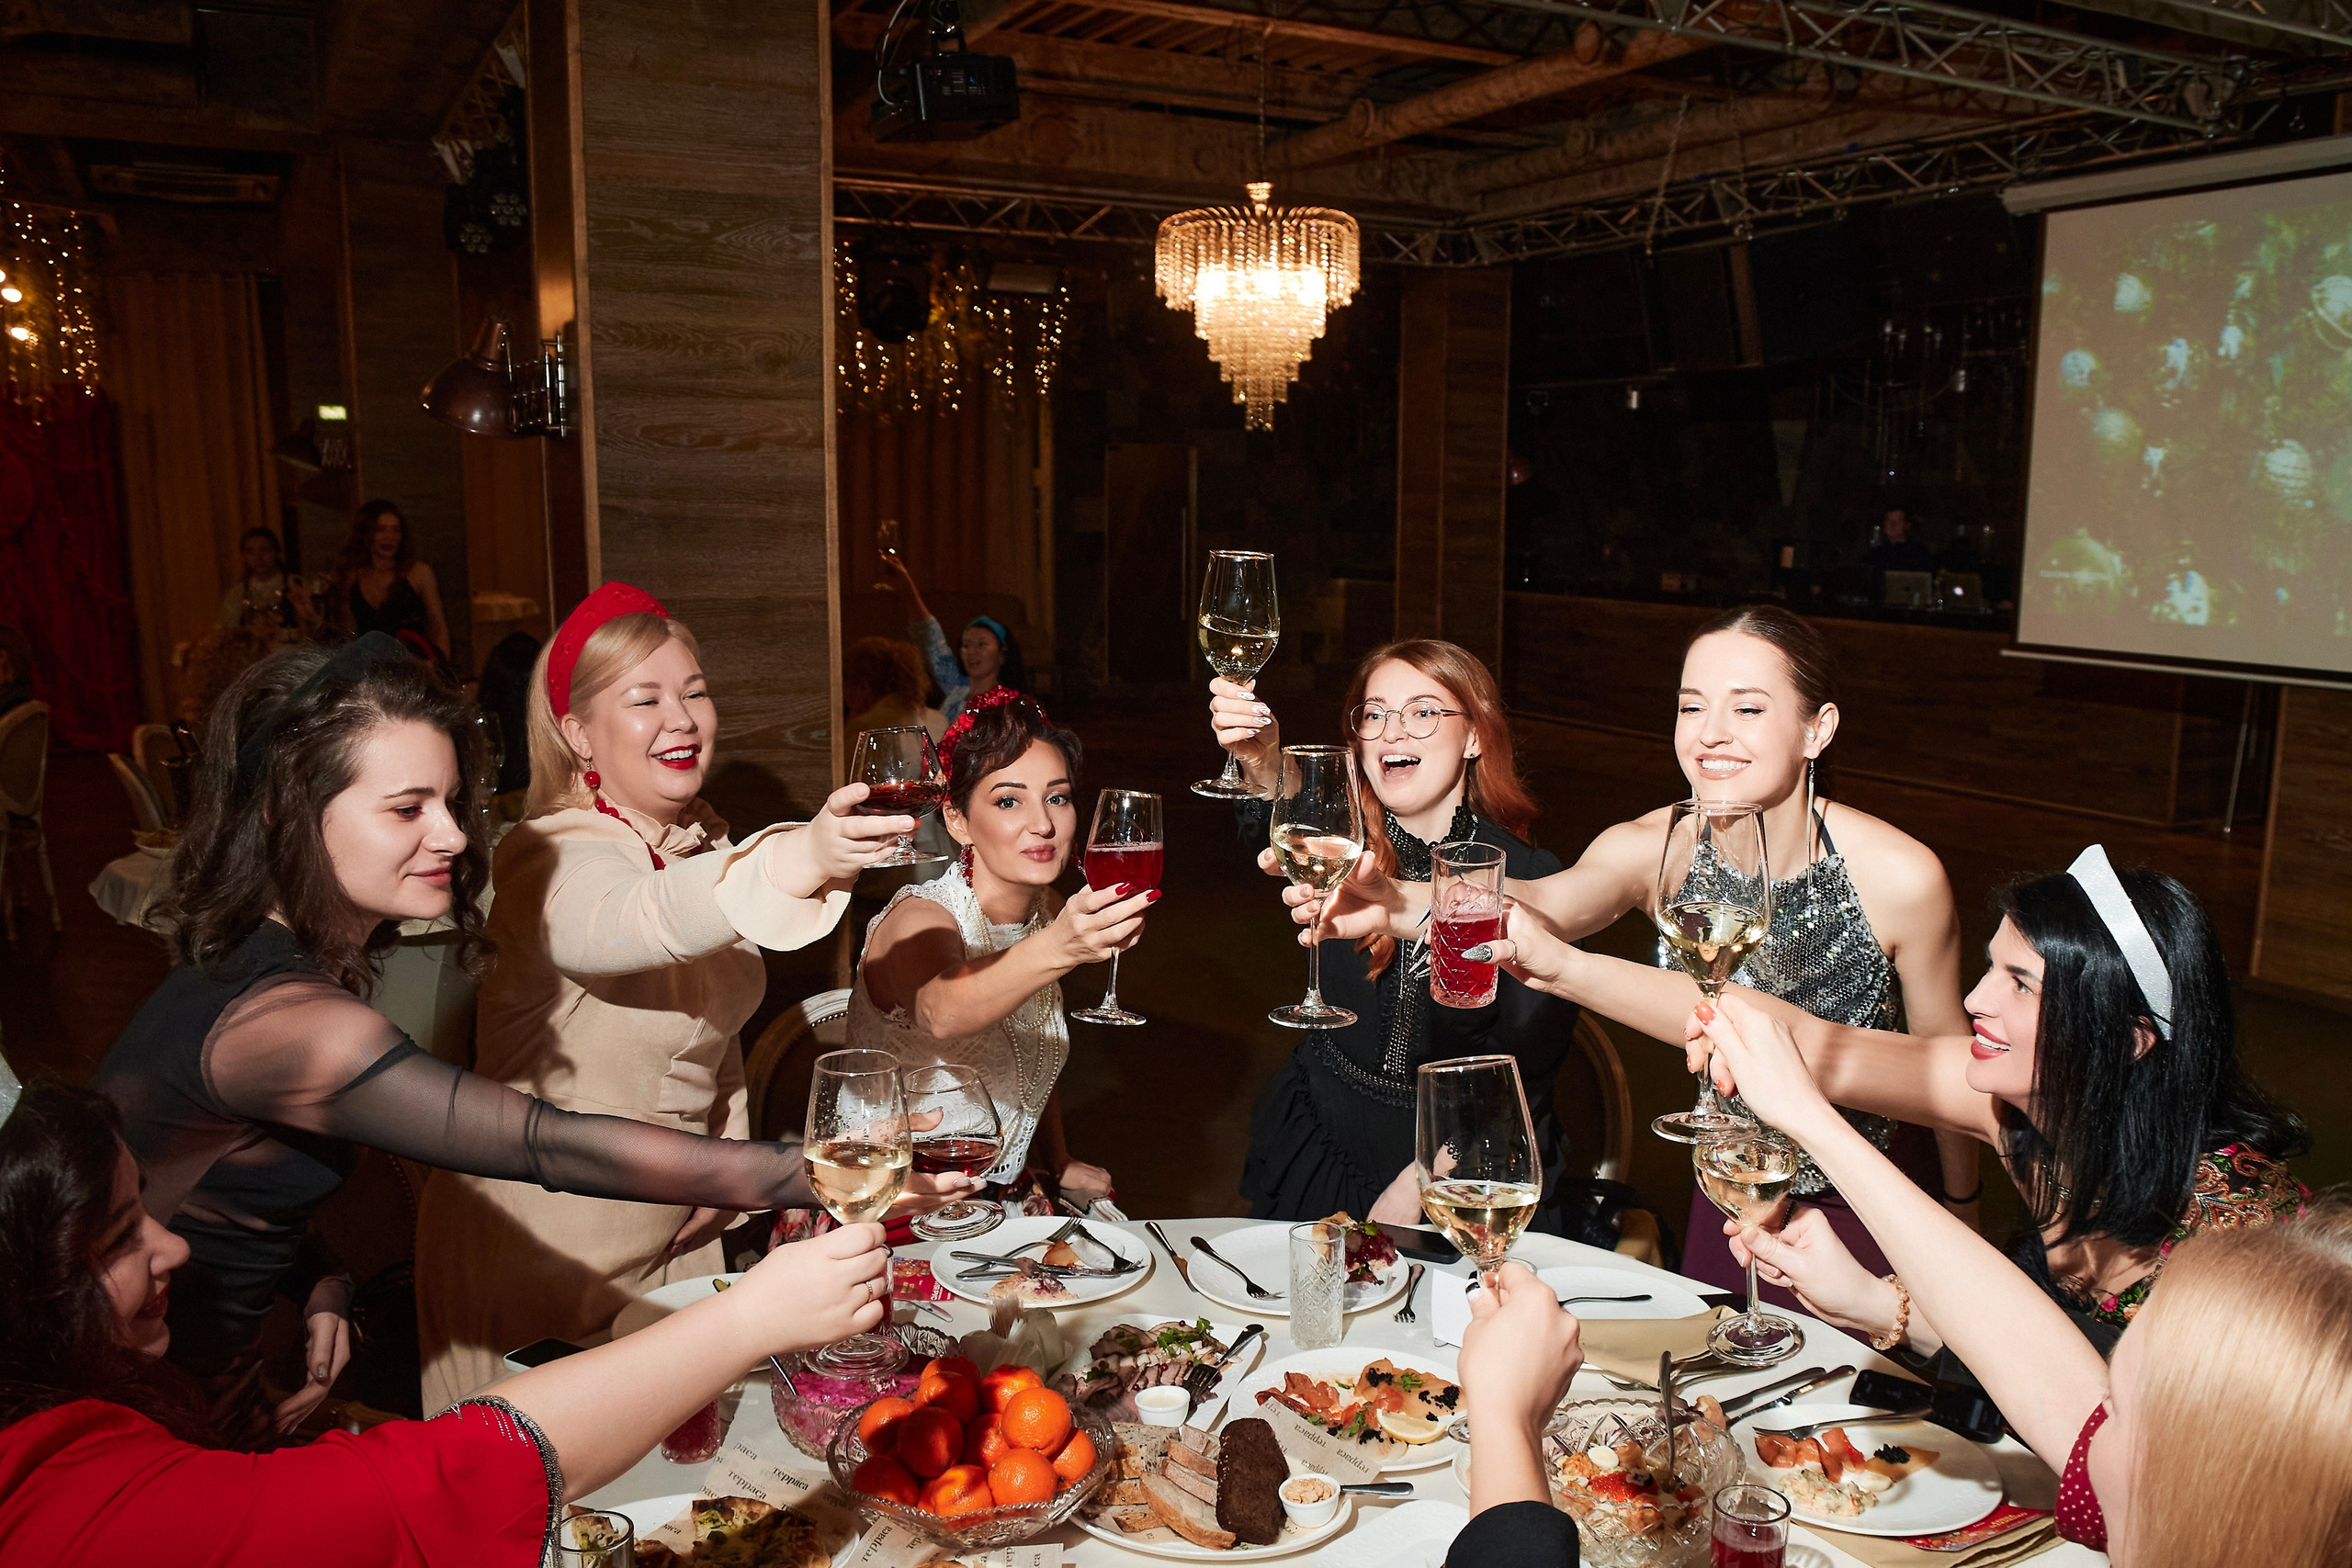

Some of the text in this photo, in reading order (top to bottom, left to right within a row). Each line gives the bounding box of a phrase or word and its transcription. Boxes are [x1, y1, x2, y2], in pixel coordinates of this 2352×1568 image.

[1294, 1424, 1327, 1448] терраса
[1336, 1449, 1370, 1474] терраса
[728, 1470, 767, 1500] терраса
[773, 1467, 809, 1491] терраса
[861, 1525, 892, 1563] терраса
